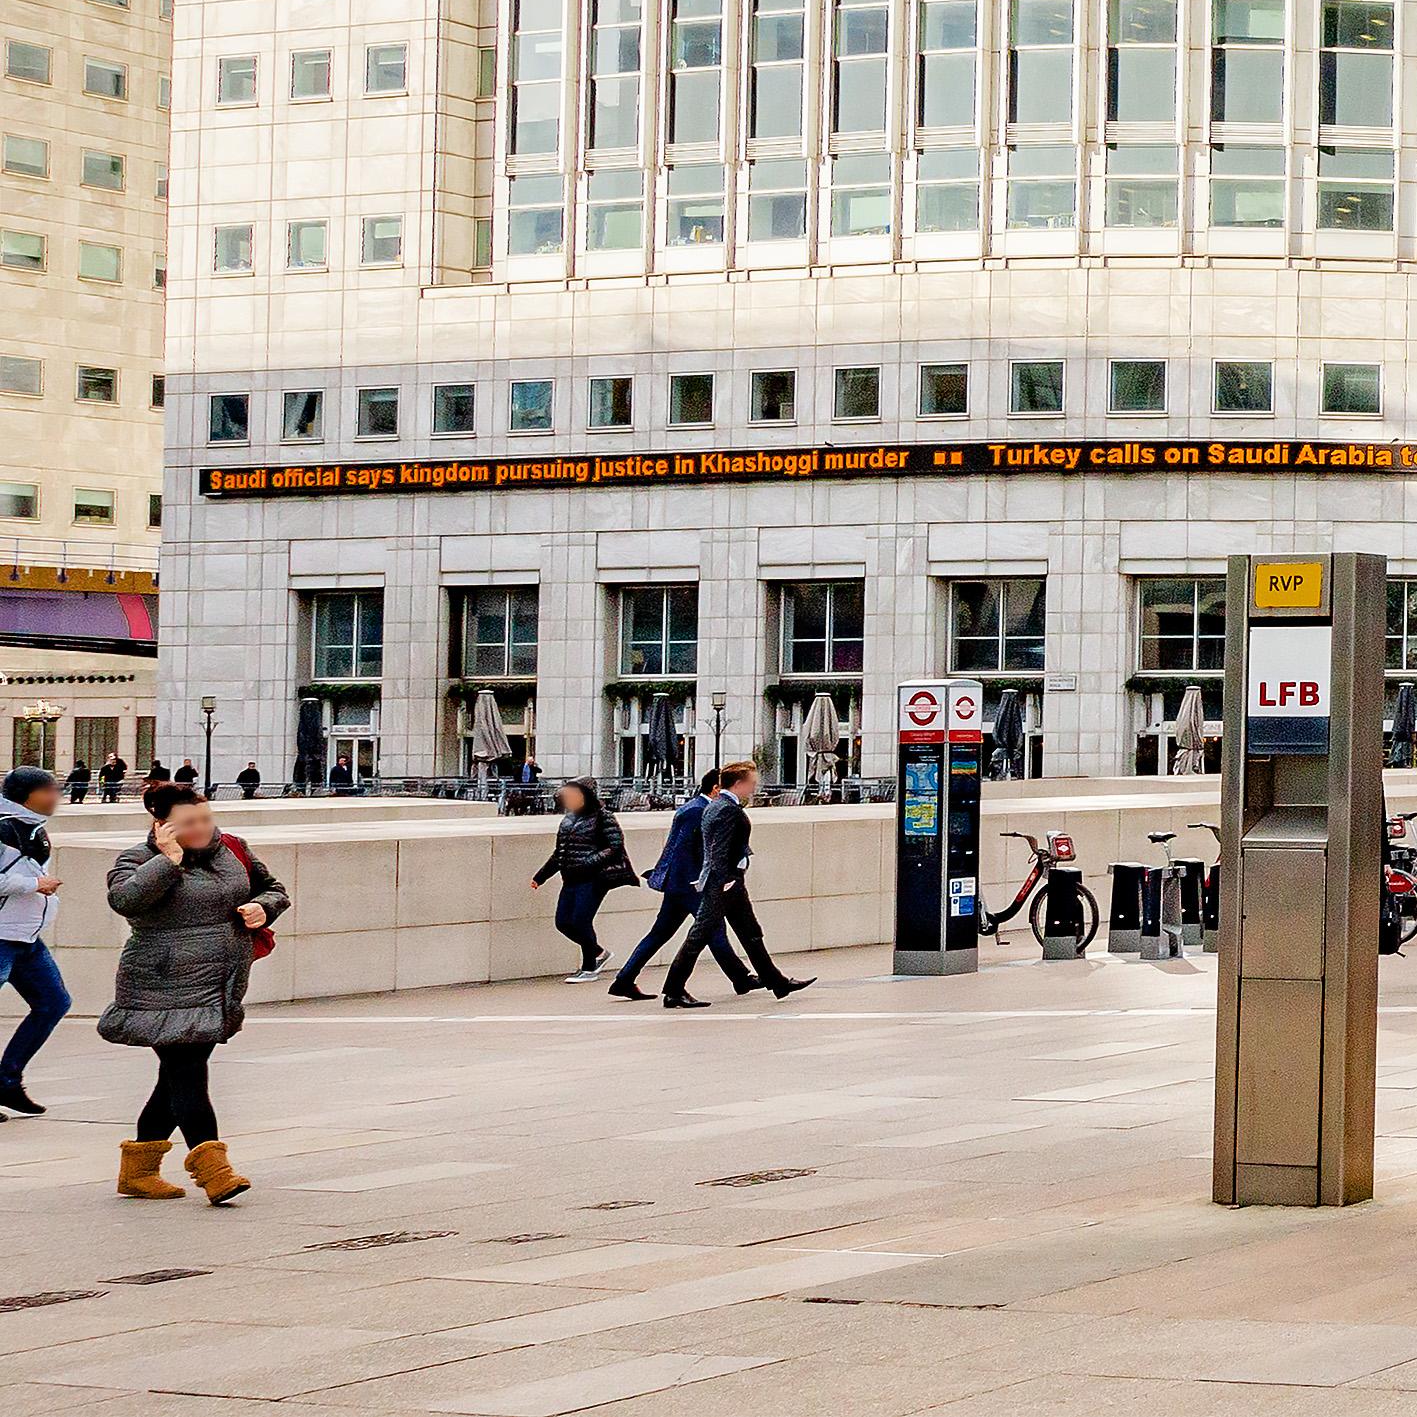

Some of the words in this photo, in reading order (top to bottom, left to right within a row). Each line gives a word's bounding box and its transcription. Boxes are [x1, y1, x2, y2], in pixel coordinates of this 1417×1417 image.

[988, 445, 1081, 468] Turkey
[1090, 444, 1155, 464] calls
[1165, 448, 1198, 464] on
[1208, 444, 1289, 464] Saudi
[1295, 445, 1392, 466] Arabia
[210, 470, 267, 489] Saudi
[273, 467, 340, 487] official
[347, 469, 394, 488] says
[401, 463, 489, 486] kingdom
[496, 460, 588, 485] pursuing
[593, 456, 668, 482] justice
[675, 455, 694, 474] in
[701, 450, 818, 474] Khashoggi
[825, 449, 910, 469] murder
[1270, 575, 1304, 592] RVP
[1259, 682, 1319, 706] LFB
